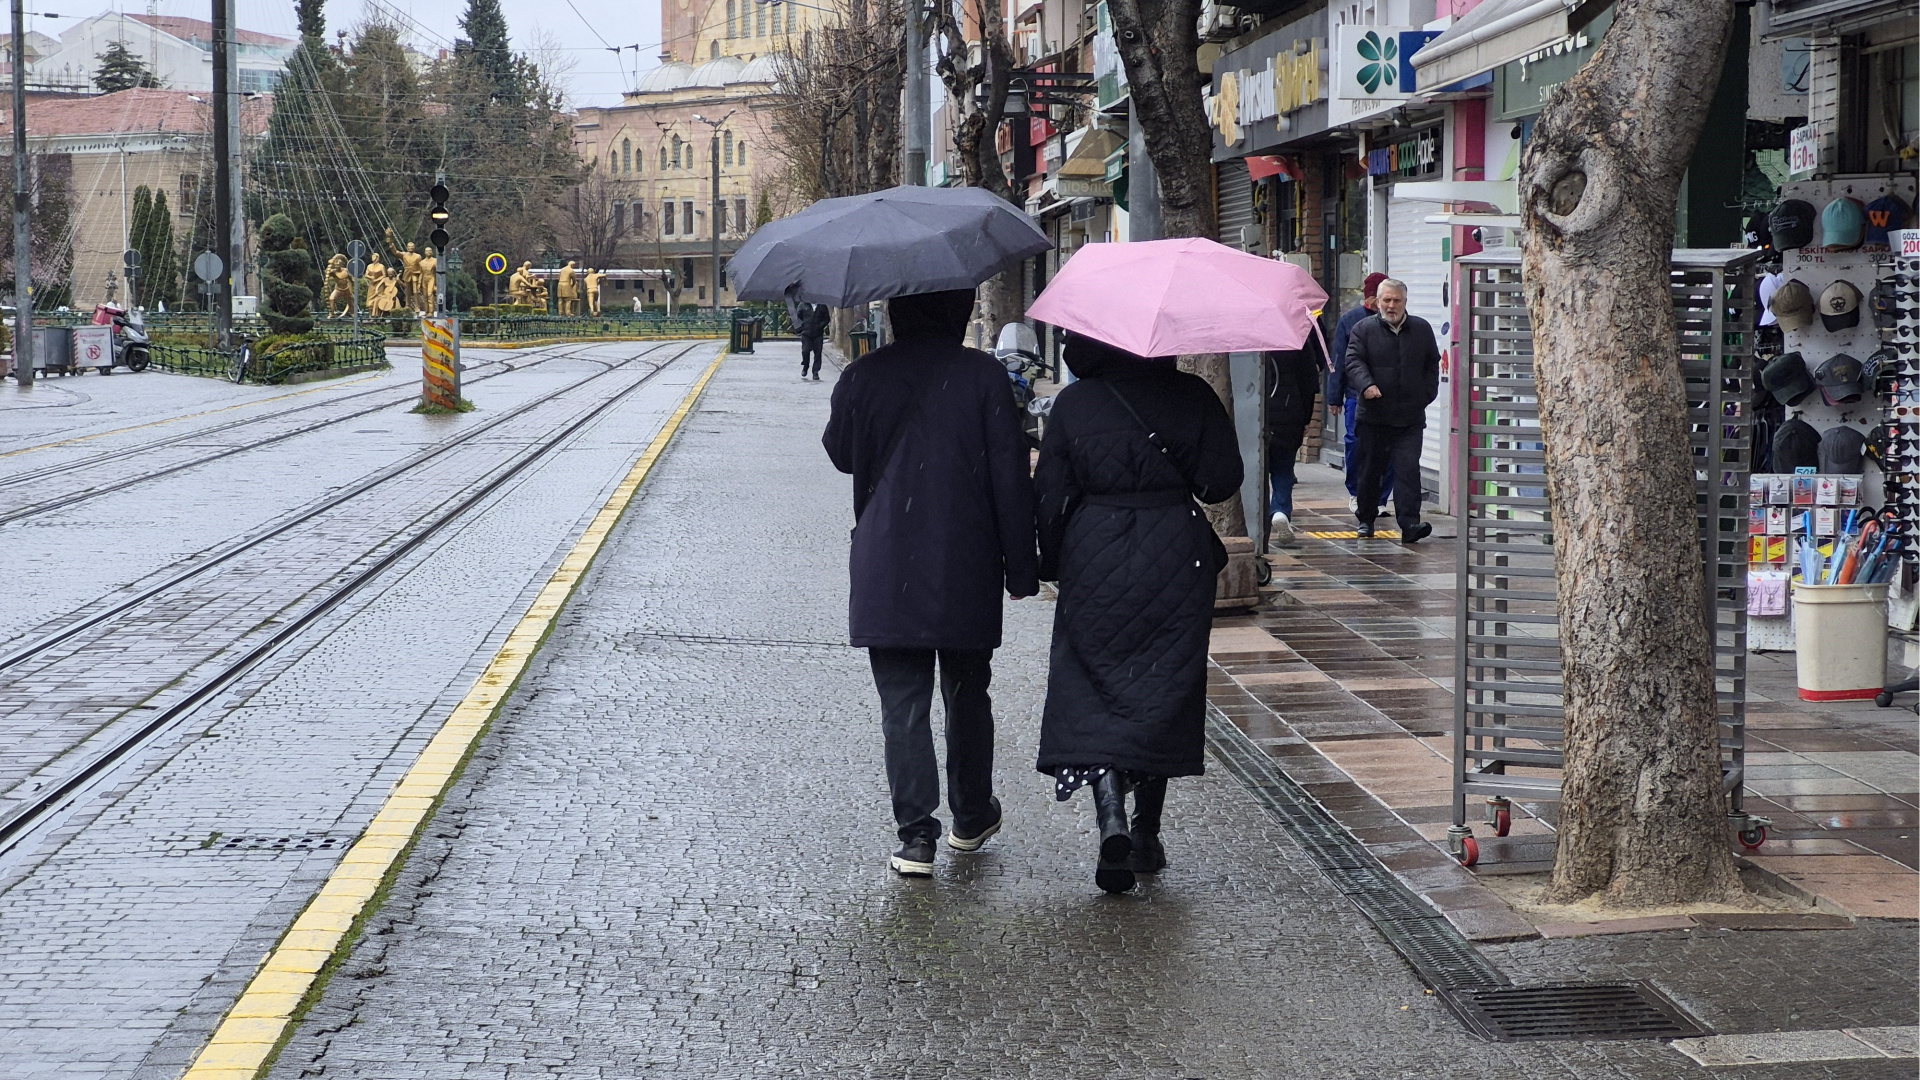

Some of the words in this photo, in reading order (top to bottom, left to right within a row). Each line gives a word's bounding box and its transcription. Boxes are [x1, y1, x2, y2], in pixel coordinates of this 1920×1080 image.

[1416, 128, 1435, 173] Apple
[1869, 210, 1891, 228] W
[1868, 253, 1887, 263] 300
